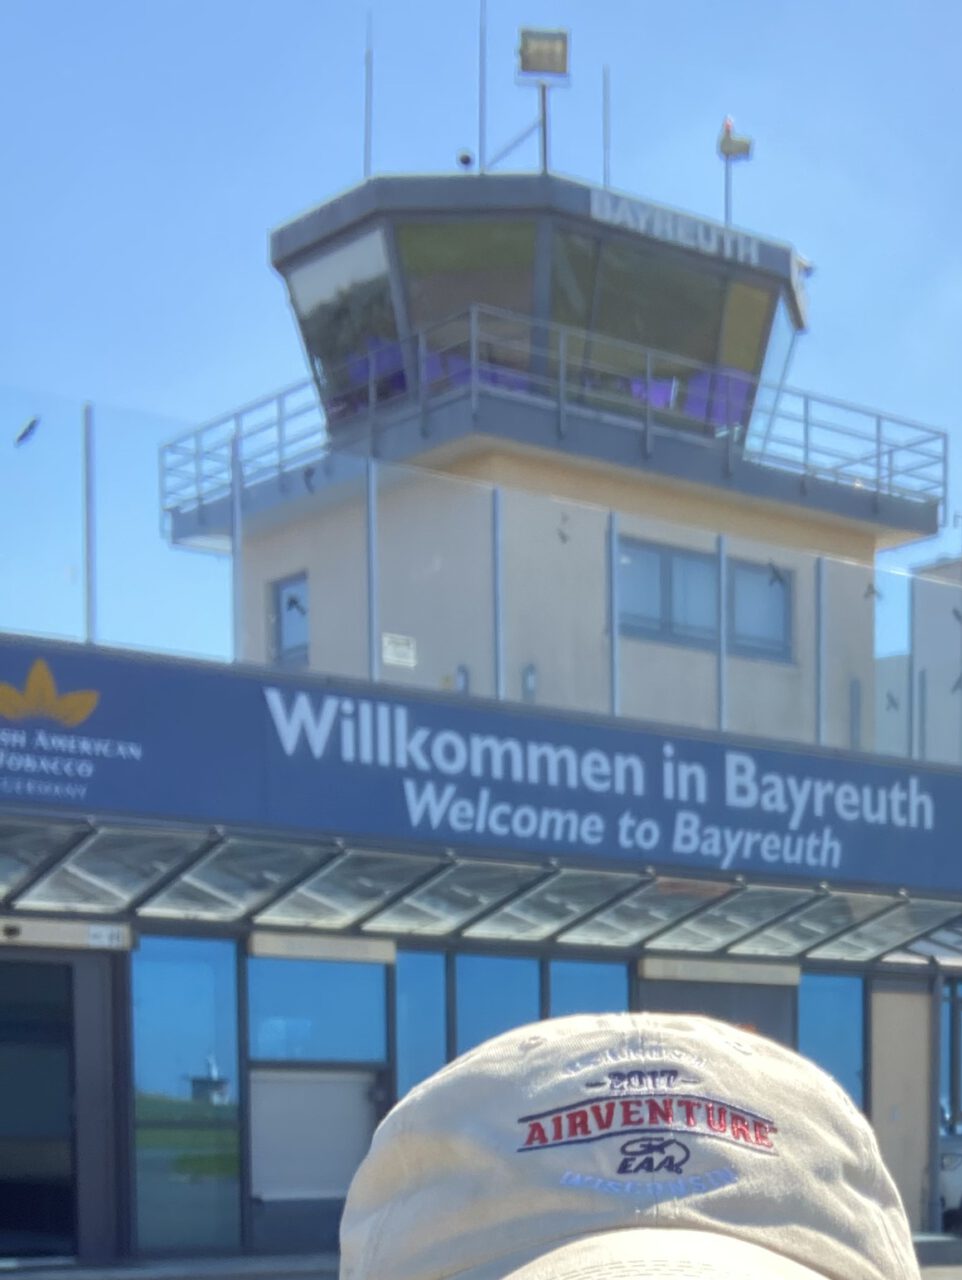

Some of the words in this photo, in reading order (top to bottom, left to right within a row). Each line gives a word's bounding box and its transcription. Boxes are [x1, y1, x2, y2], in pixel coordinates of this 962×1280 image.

[591, 188, 759, 266] BAYREUTH
[33, 728, 143, 761] AMERICAN
[264, 687, 645, 797] Willkommen
[662, 742, 707, 804] in
[725, 752, 935, 831] Bayreuth
[403, 778, 605, 845] Welcome
[618, 810, 661, 849] to
[672, 810, 843, 870] Bayreuth
[607, 1069, 679, 1092] 2017
[524, 1097, 776, 1150] AIRVENTURE
[616, 1155, 678, 1175] EAA
